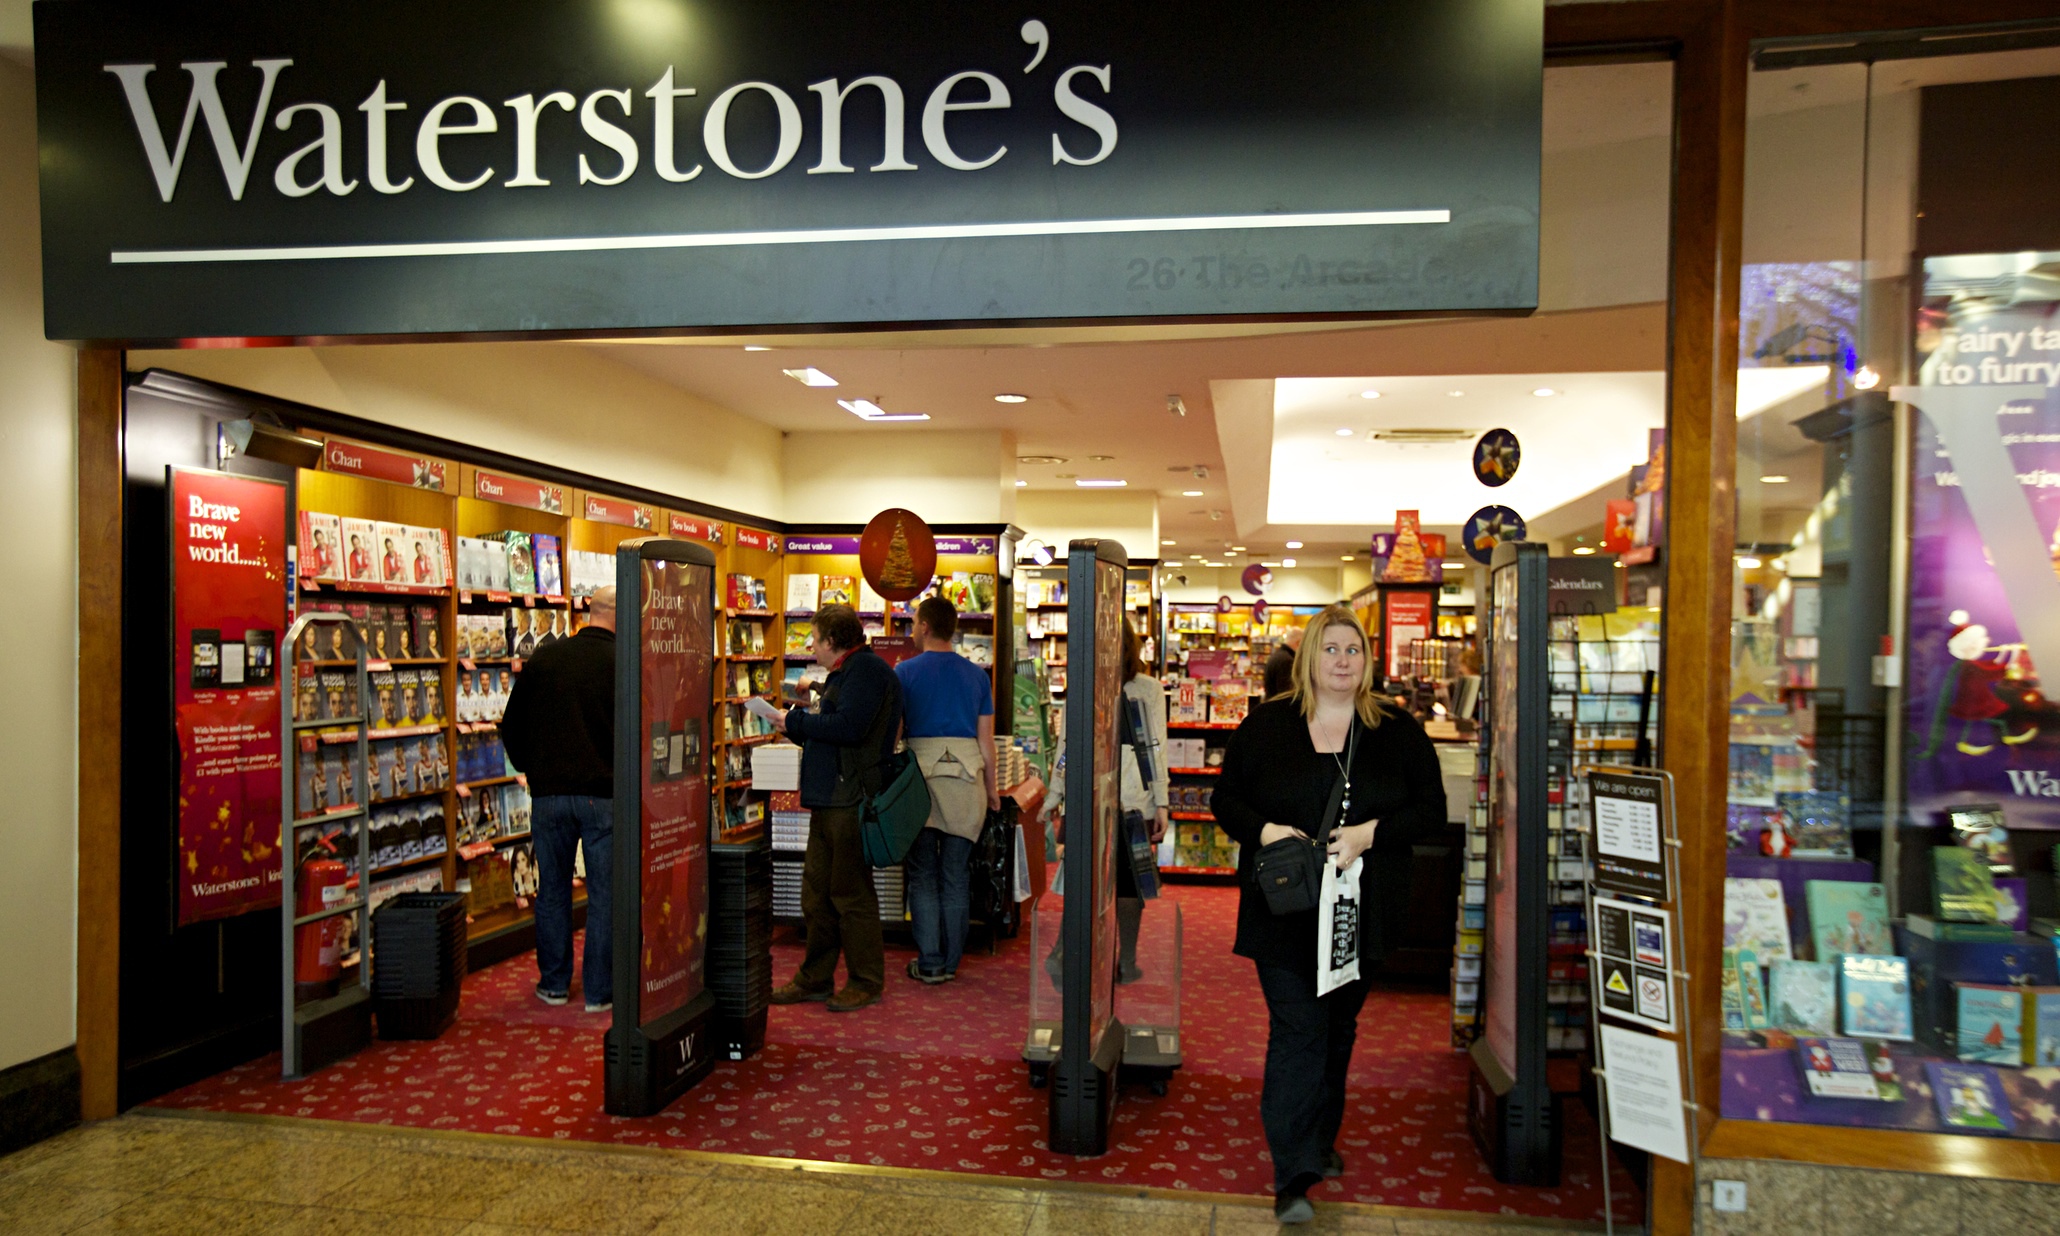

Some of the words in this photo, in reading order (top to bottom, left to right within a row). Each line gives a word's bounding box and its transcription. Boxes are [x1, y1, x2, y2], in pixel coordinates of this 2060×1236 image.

[103, 19, 1119, 203] Waterstone's
[1126, 257, 1177, 291] 26
[1190, 253, 1270, 290] The
[1937, 363, 1974, 385] to
[331, 450, 363, 469] Chart
[481, 479, 503, 496] Chart
[189, 495, 241, 522] Brave
[588, 503, 607, 517] Chart
[189, 522, 228, 541] new
[672, 518, 682, 531] New
[683, 521, 698, 535] books
[738, 531, 747, 542] New
[788, 542, 811, 550] Great
[811, 542, 833, 550] value
[936, 542, 961, 550] ildren
[652, 589, 684, 610] Brave
[651, 616, 676, 631] new
[1180, 689, 1194, 702] EYE
[1594, 780, 1610, 792] We
[1611, 784, 1626, 794] are
[192, 876, 260, 898] Waterstones
[679, 1033, 695, 1064] W
